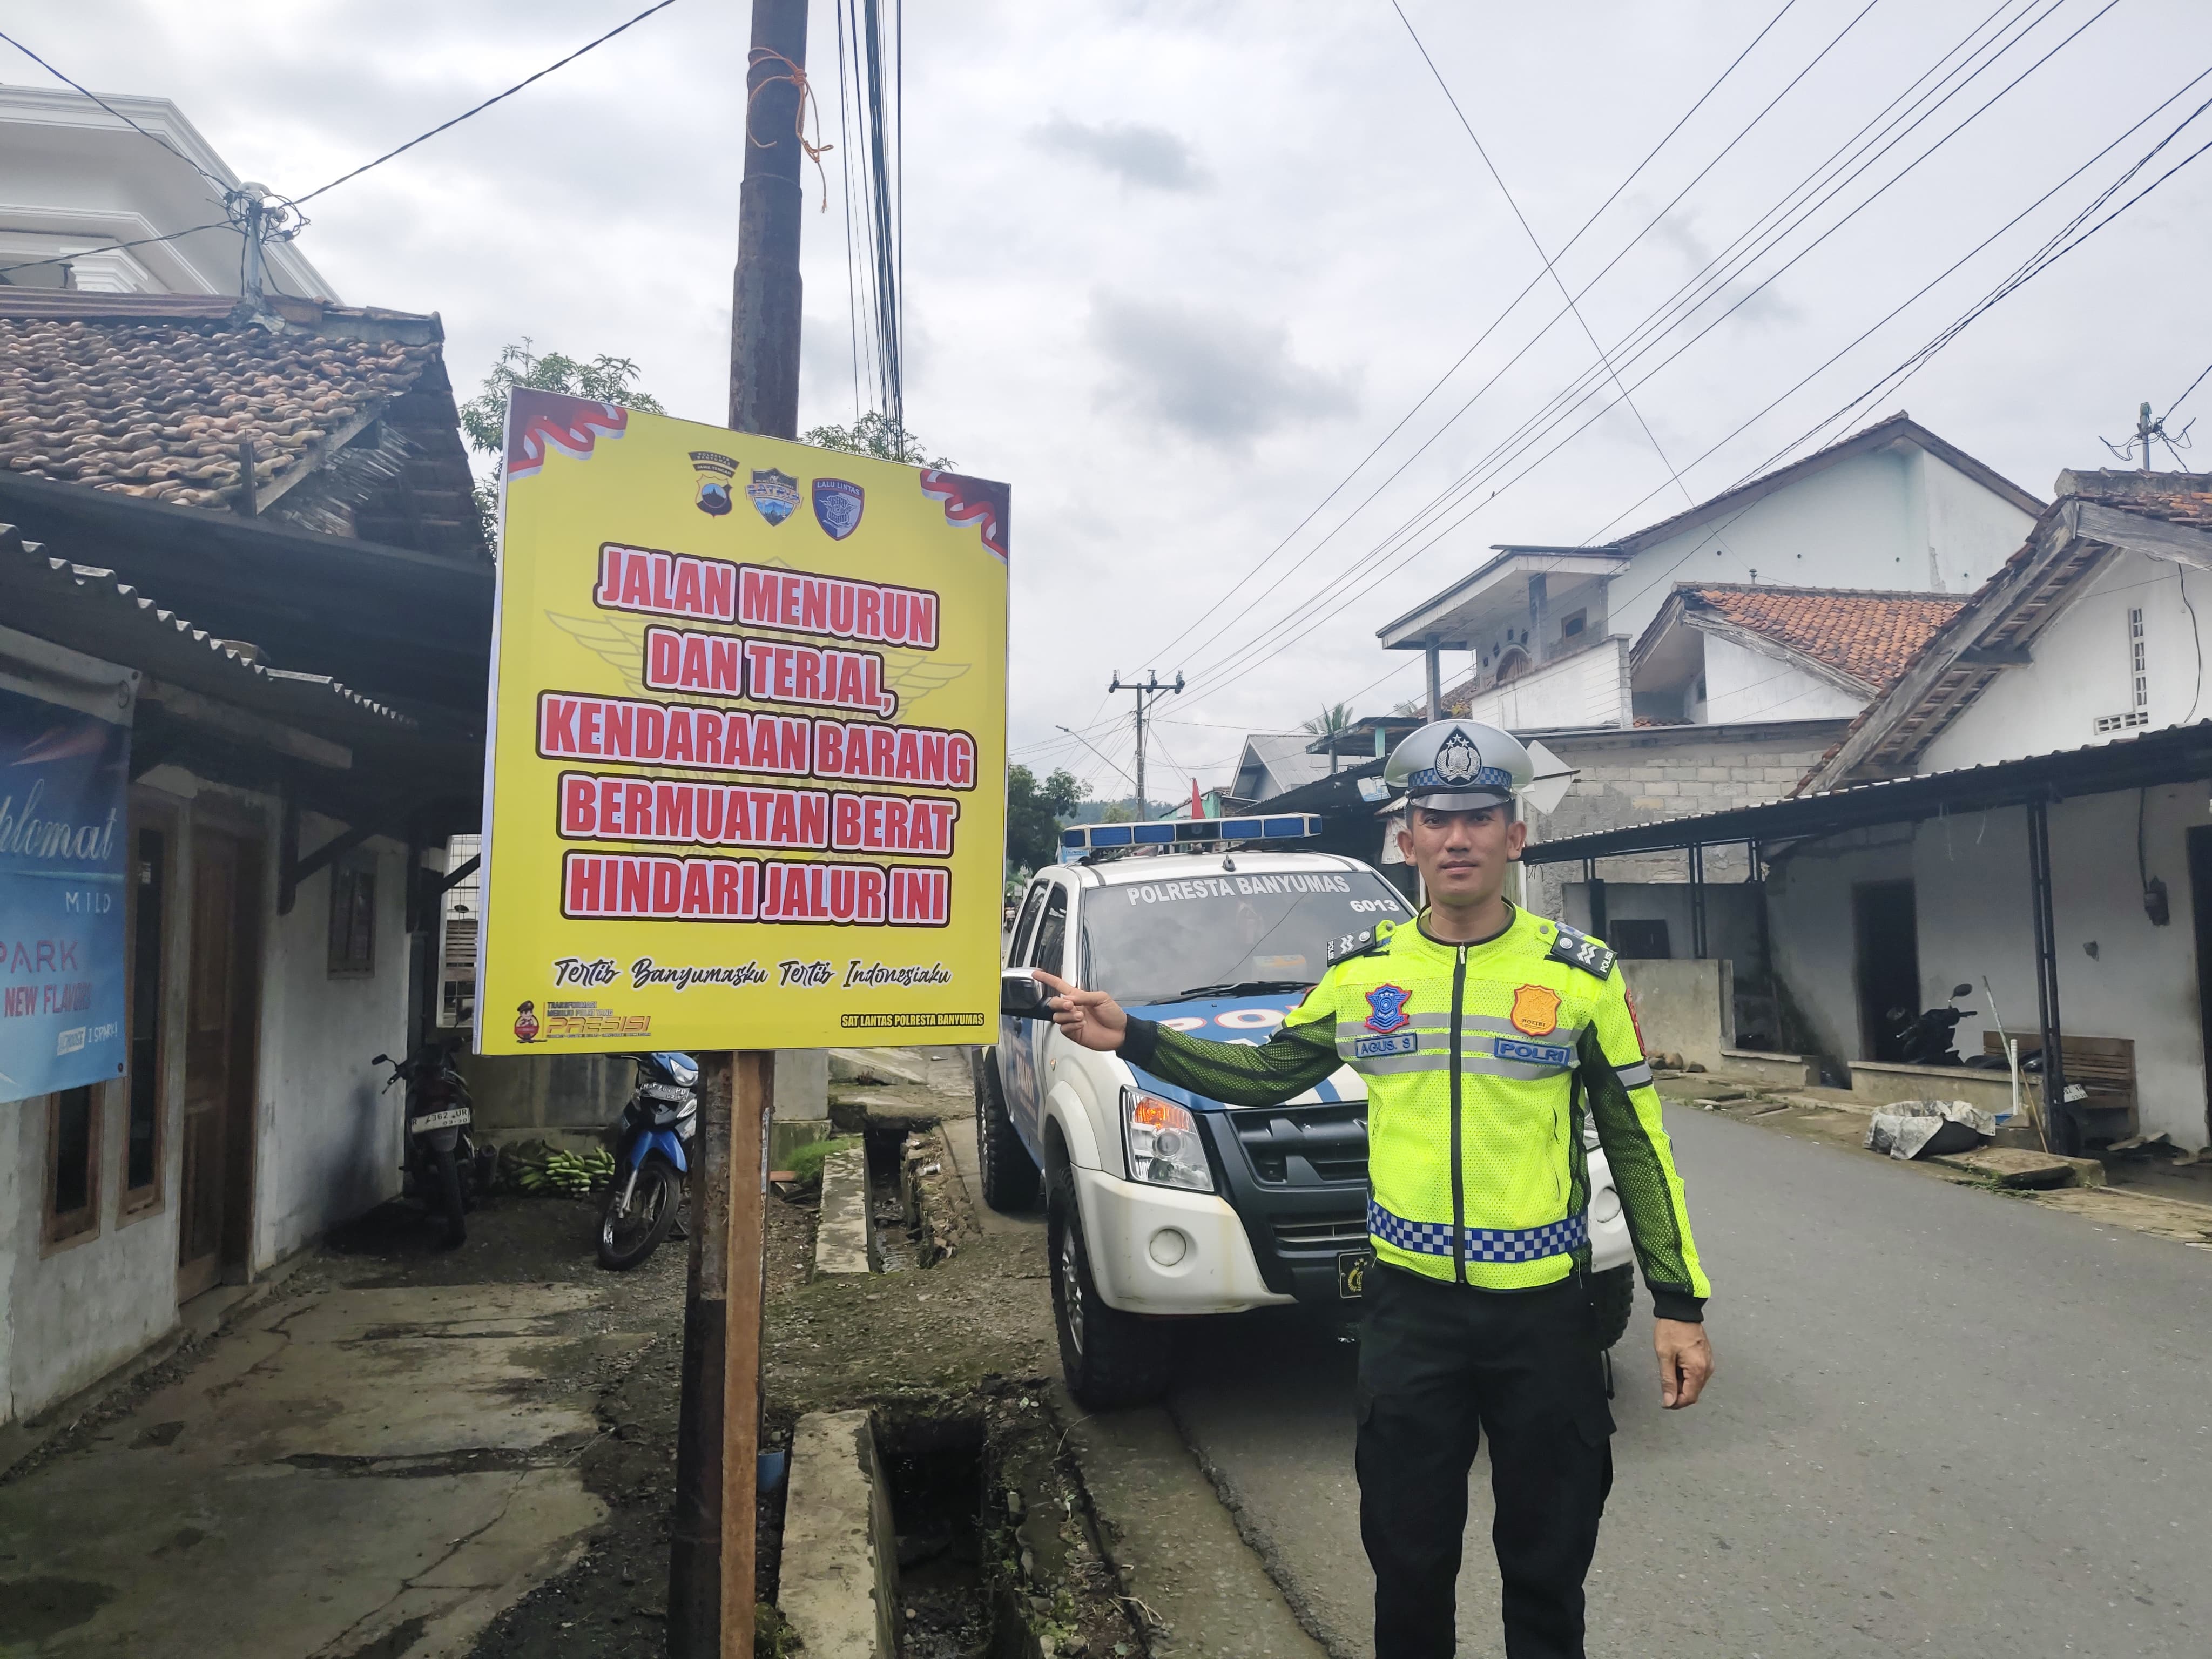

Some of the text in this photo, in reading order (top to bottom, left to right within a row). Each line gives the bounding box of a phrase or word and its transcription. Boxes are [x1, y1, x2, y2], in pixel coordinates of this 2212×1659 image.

[837, 482, 860, 496] LINTAS
[602, 550, 934, 645] JALAN MENURUN
[650, 632, 892, 712] DAN TERJAL,
[544, 698, 972, 785] KENDARAAN BARANG
[565, 778, 954, 852] BERMUATAN BERAT
[65, 891, 111, 913] MILD
[569, 858, 946, 921] HINDARI JALUR INI
[1126, 875, 1351, 906] POLRESTA BANYUMAS
[1350, 899, 1400, 913] 6013
[555, 958, 952, 990] Tertib Banyumasku Tertib Indonesiaku
[1600, 951, 1614, 973] POLISI
[4, 986, 38, 1017] NEW
[546, 1016, 651, 1033] PRESISI
[842, 1014, 983, 1026] SAT LANTAS POLRESTA BANYUMAS
[1361, 1038, 1411, 1054] AGUS. S
[1500, 1043, 1564, 1062] POLRI
